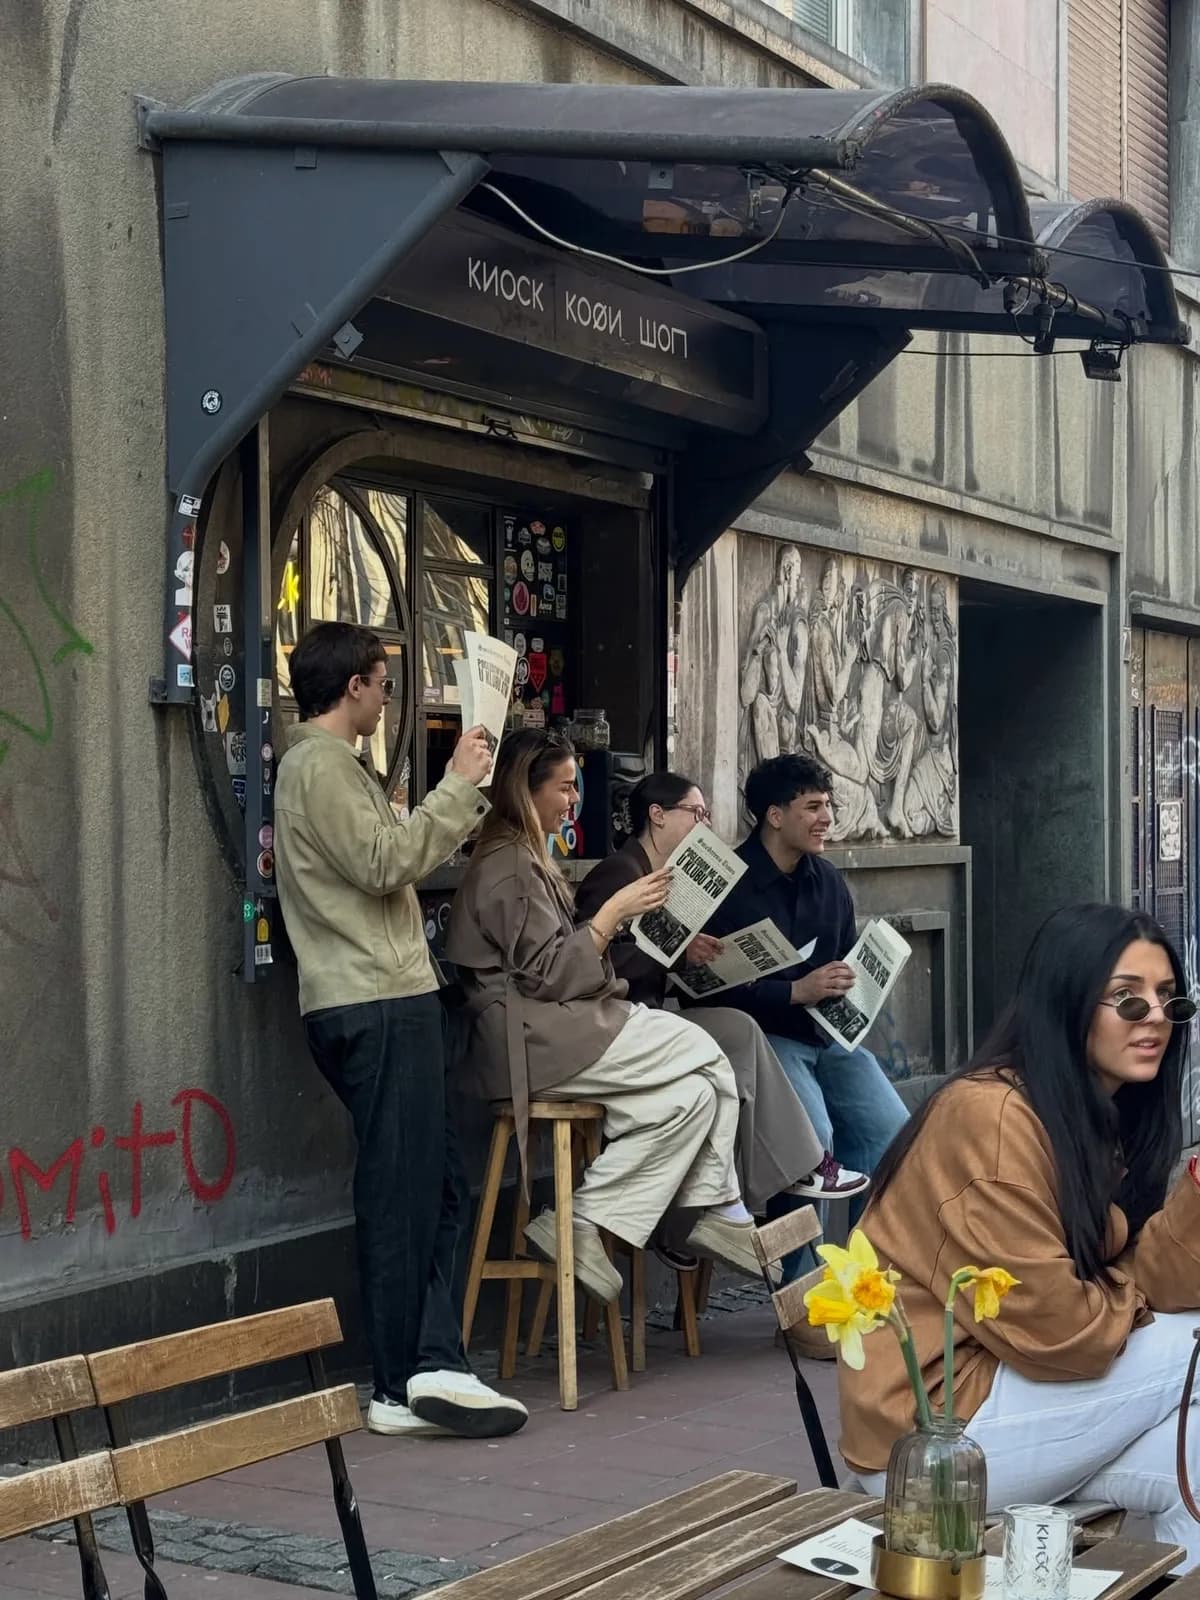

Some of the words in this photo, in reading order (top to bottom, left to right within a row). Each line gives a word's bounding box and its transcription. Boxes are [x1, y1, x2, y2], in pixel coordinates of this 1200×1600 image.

[468, 256, 544, 312] КИОСК
[639, 316, 688, 359] ШОП
[676, 853, 689, 866] U
[681, 858, 709, 886] KLUBU
